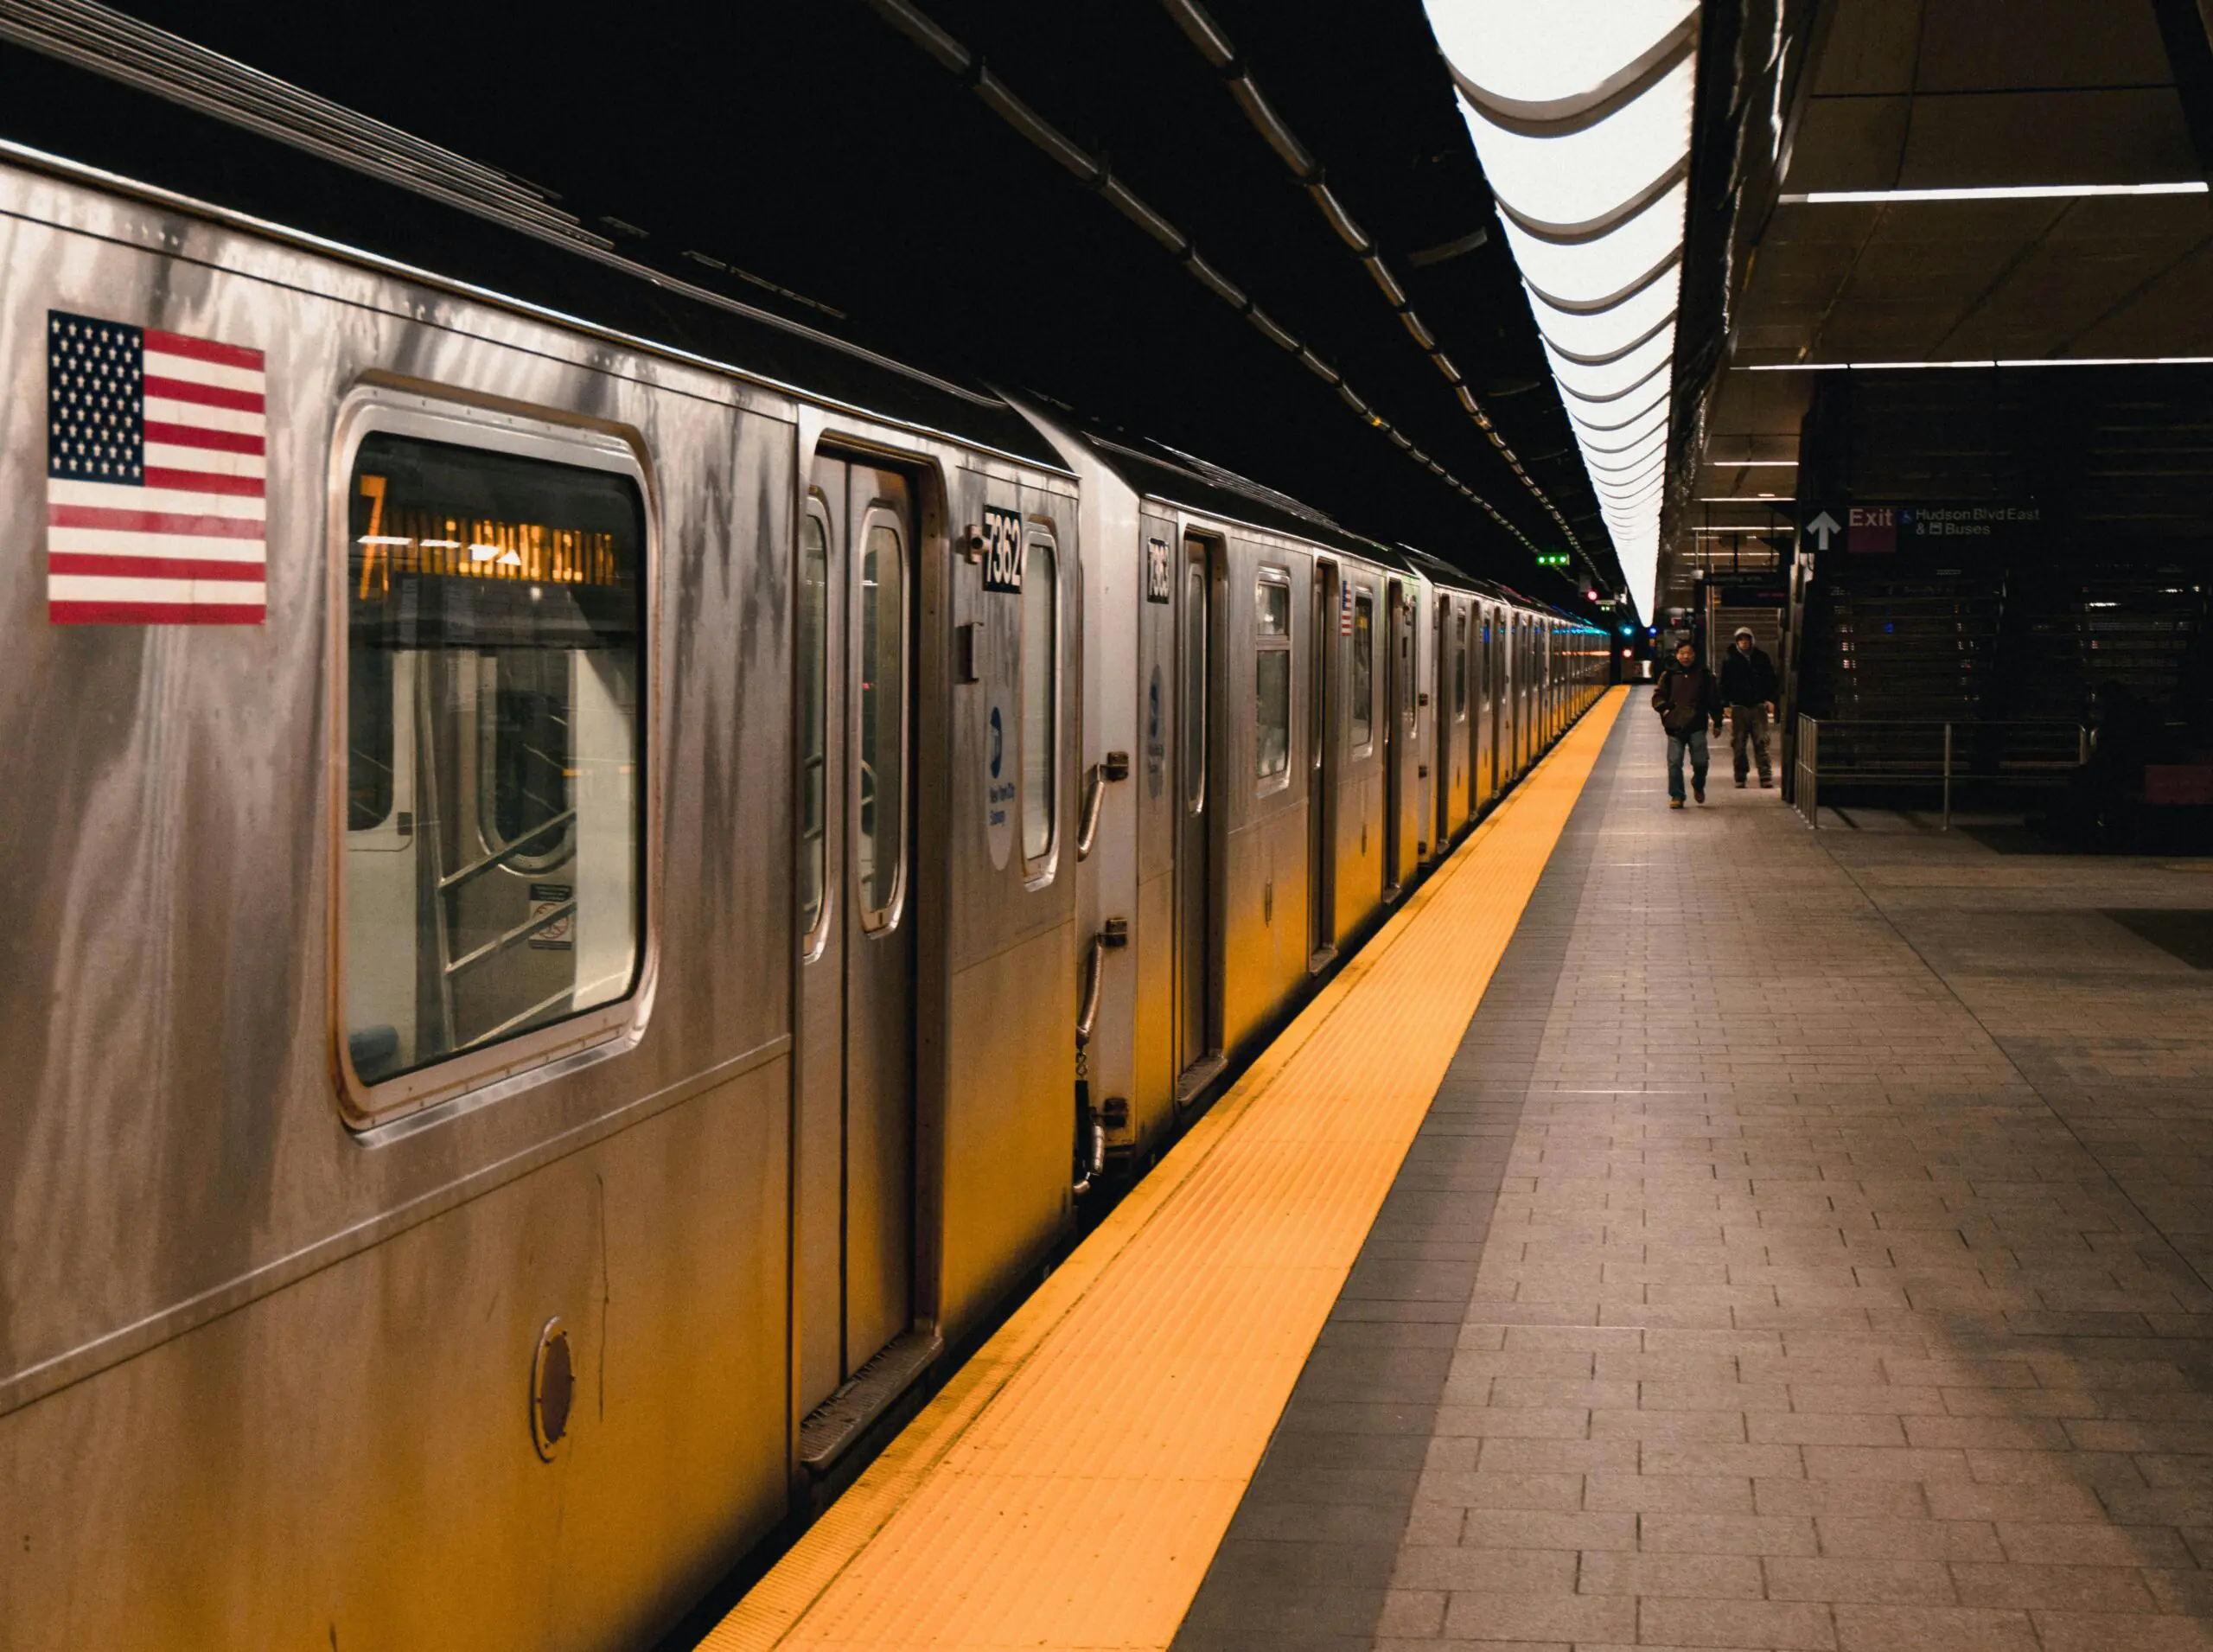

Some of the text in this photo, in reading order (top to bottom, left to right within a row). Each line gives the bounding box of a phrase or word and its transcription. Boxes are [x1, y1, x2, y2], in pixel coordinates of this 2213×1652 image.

[1849, 508, 1893, 526] Exit
[1916, 508, 2040, 521] Hudson Blvd East
[1916, 522, 1991, 535] & Buses
[985, 512, 1021, 586] 7362
